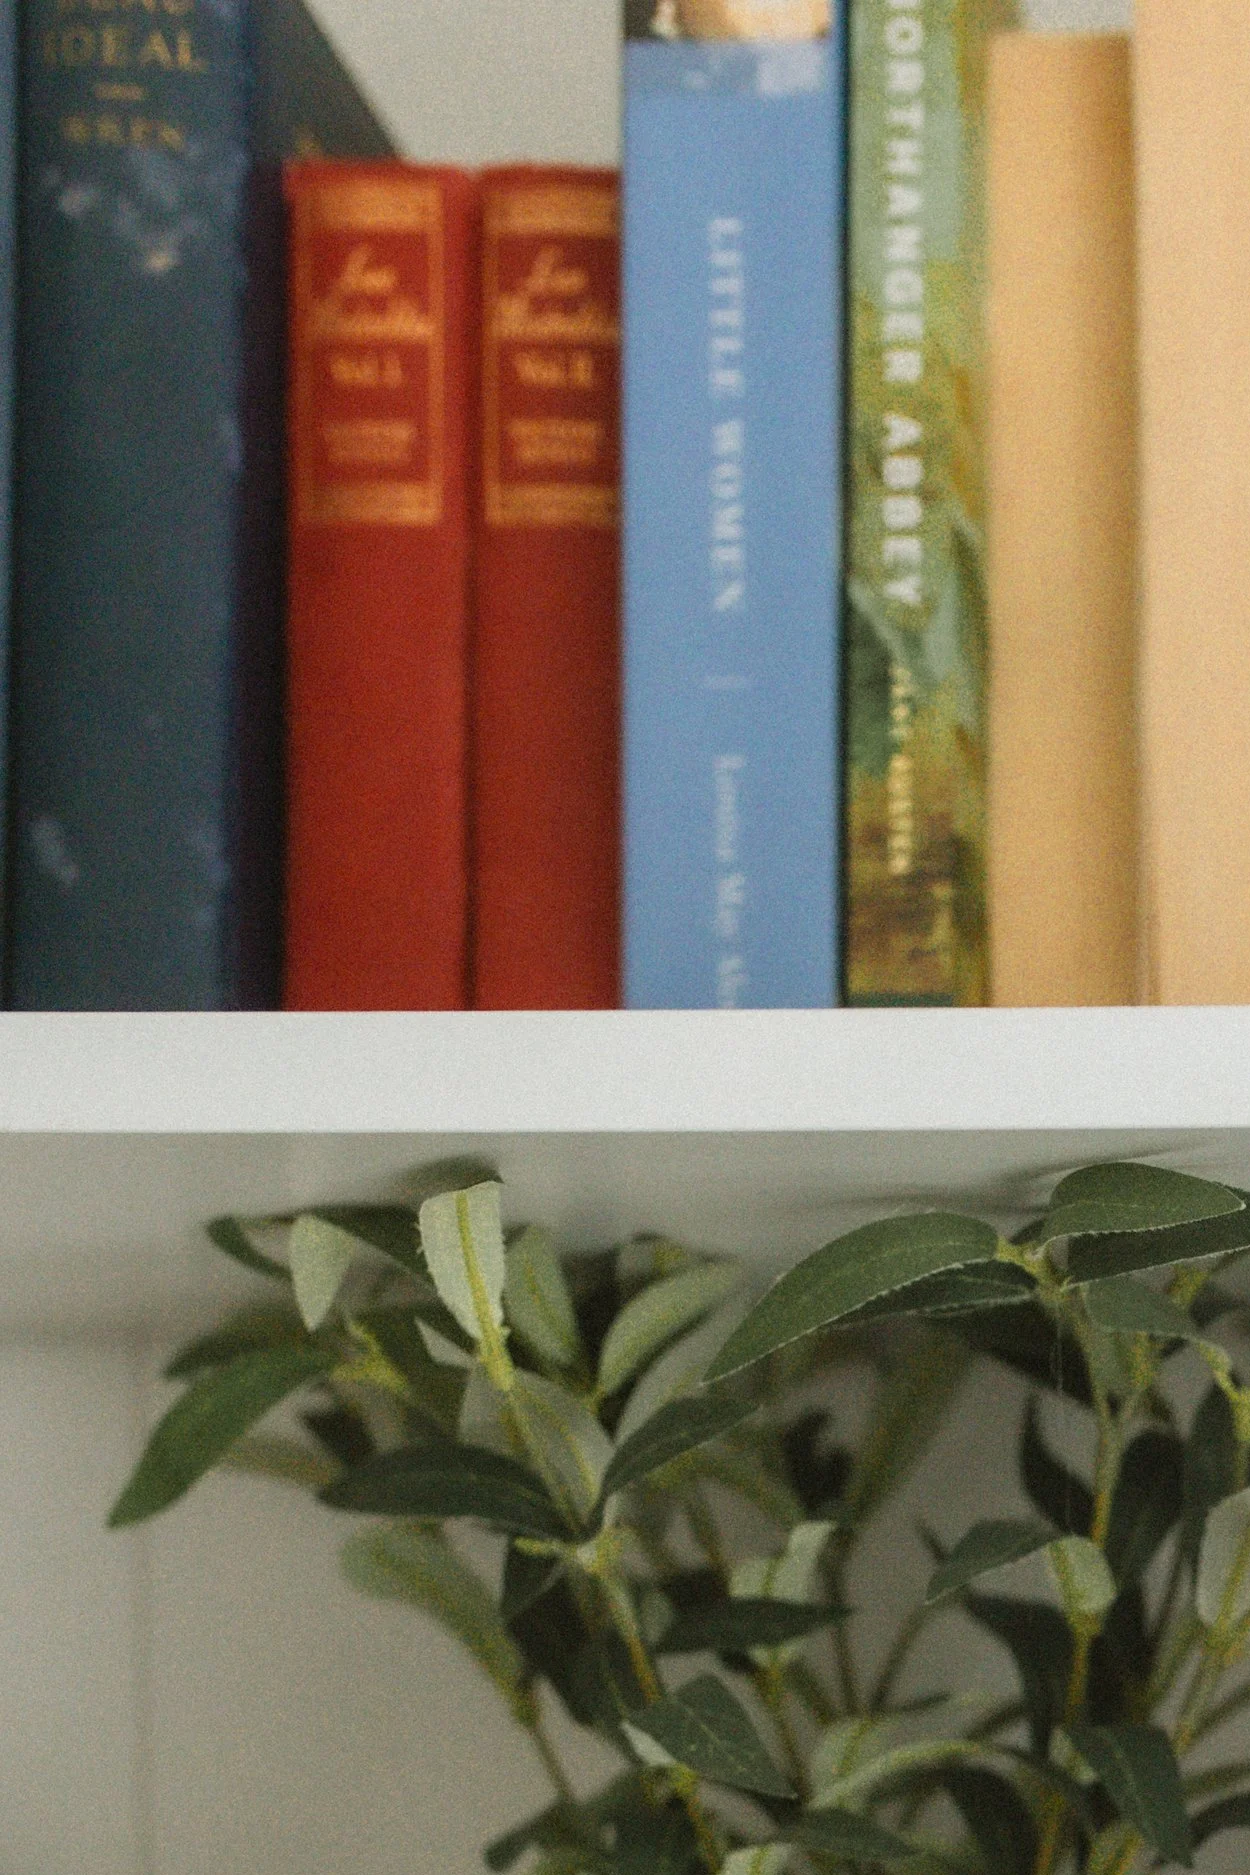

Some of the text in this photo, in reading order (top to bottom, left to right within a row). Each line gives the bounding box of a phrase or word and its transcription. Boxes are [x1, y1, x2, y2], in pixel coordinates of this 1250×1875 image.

[709, 217, 746, 609] LITTLE WOMEN
[882, 0, 923, 608] ORTHANGER ABBEY
